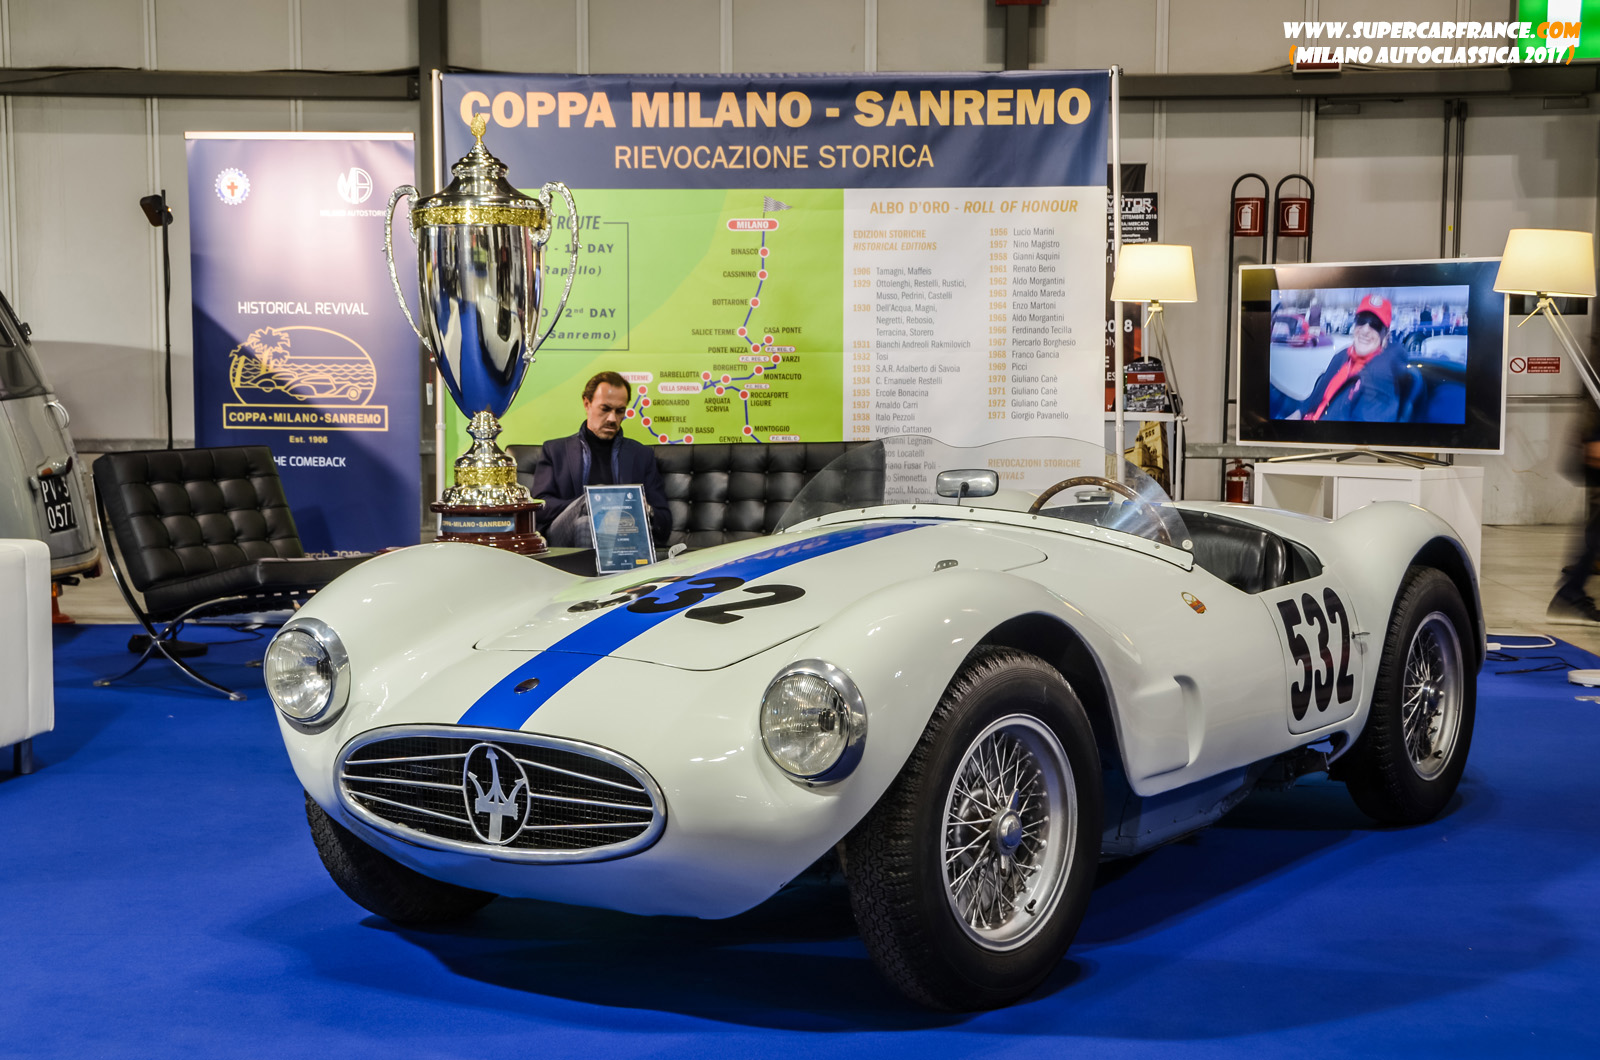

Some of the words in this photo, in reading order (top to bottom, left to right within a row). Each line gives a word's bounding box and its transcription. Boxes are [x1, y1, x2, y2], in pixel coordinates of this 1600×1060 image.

[460, 91, 616, 128] COPPA
[632, 91, 812, 128] MILANO
[854, 88, 1091, 127] SANREMO
[614, 146, 808, 169] RIEVOCAZIONE
[818, 144, 934, 168] STORICA
[870, 201, 904, 214] ALBO
[909, 201, 950, 214] D'ORO
[963, 201, 995, 214] ROLL
[1000, 200, 1018, 213] OF
[1022, 200, 1078, 213] HONOUR
[853, 230, 887, 238] EDIZIONI
[889, 230, 926, 238] STORICHE
[588, 244, 614, 253] DAY
[853, 242, 898, 251] HISTORICAL
[901, 242, 937, 250] EDITIONS
[1031, 240, 1060, 249] Magistro
[1036, 252, 1060, 262] Asquini
[853, 267, 871, 276] 1906
[876, 267, 906, 277] Tamagni,
[908, 267, 932, 275] Maffeis
[876, 280, 912, 289] Ottolenghi,
[914, 280, 940, 288] Restelli,
[942, 280, 967, 288] Rustici,
[1030, 277, 1065, 286] Morgantini
[876, 292, 900, 301] Musso,
[901, 292, 926, 301] Pedrini,
[928, 292, 952, 300] Castelli
[238, 302, 312, 315] HISTORICAL
[315, 302, 368, 315] REVIVAL
[853, 304, 871, 312] 1930
[915, 304, 937, 313] Magni,
[590, 309, 616, 318] DAY
[876, 316, 904, 326] Negretti,
[906, 316, 934, 325] Rebosio,
[1029, 314, 1064, 323] Morgantini
[876, 328, 908, 337] Terracina,
[910, 328, 934, 336] Storero
[853, 340, 871, 348] 1931
[876, 340, 900, 348] Bianchi
[902, 340, 929, 348] Andreoli
[931, 340, 970, 348] Rakmilovich
[1043, 338, 1076, 348] Borghesio
[896, 364, 928, 372] Adalberto
[930, 364, 936, 372] di
[938, 364, 960, 372] Savoia
[229, 412, 267, 422] COPPA
[274, 413, 318, 423] MILANO
[324, 414, 381, 424] SANREMO
[1011, 411, 1034, 420] Giorgio
[875, 425, 900, 434] Virginio
[289, 456, 346, 467] COMEBACK
[988, 459, 1040, 468] RIEVOCAZIONI
[1044, 459, 1080, 468] STORICHE
[893, 474, 927, 482] Simonetta
[1276, 587, 1354, 721] 532
